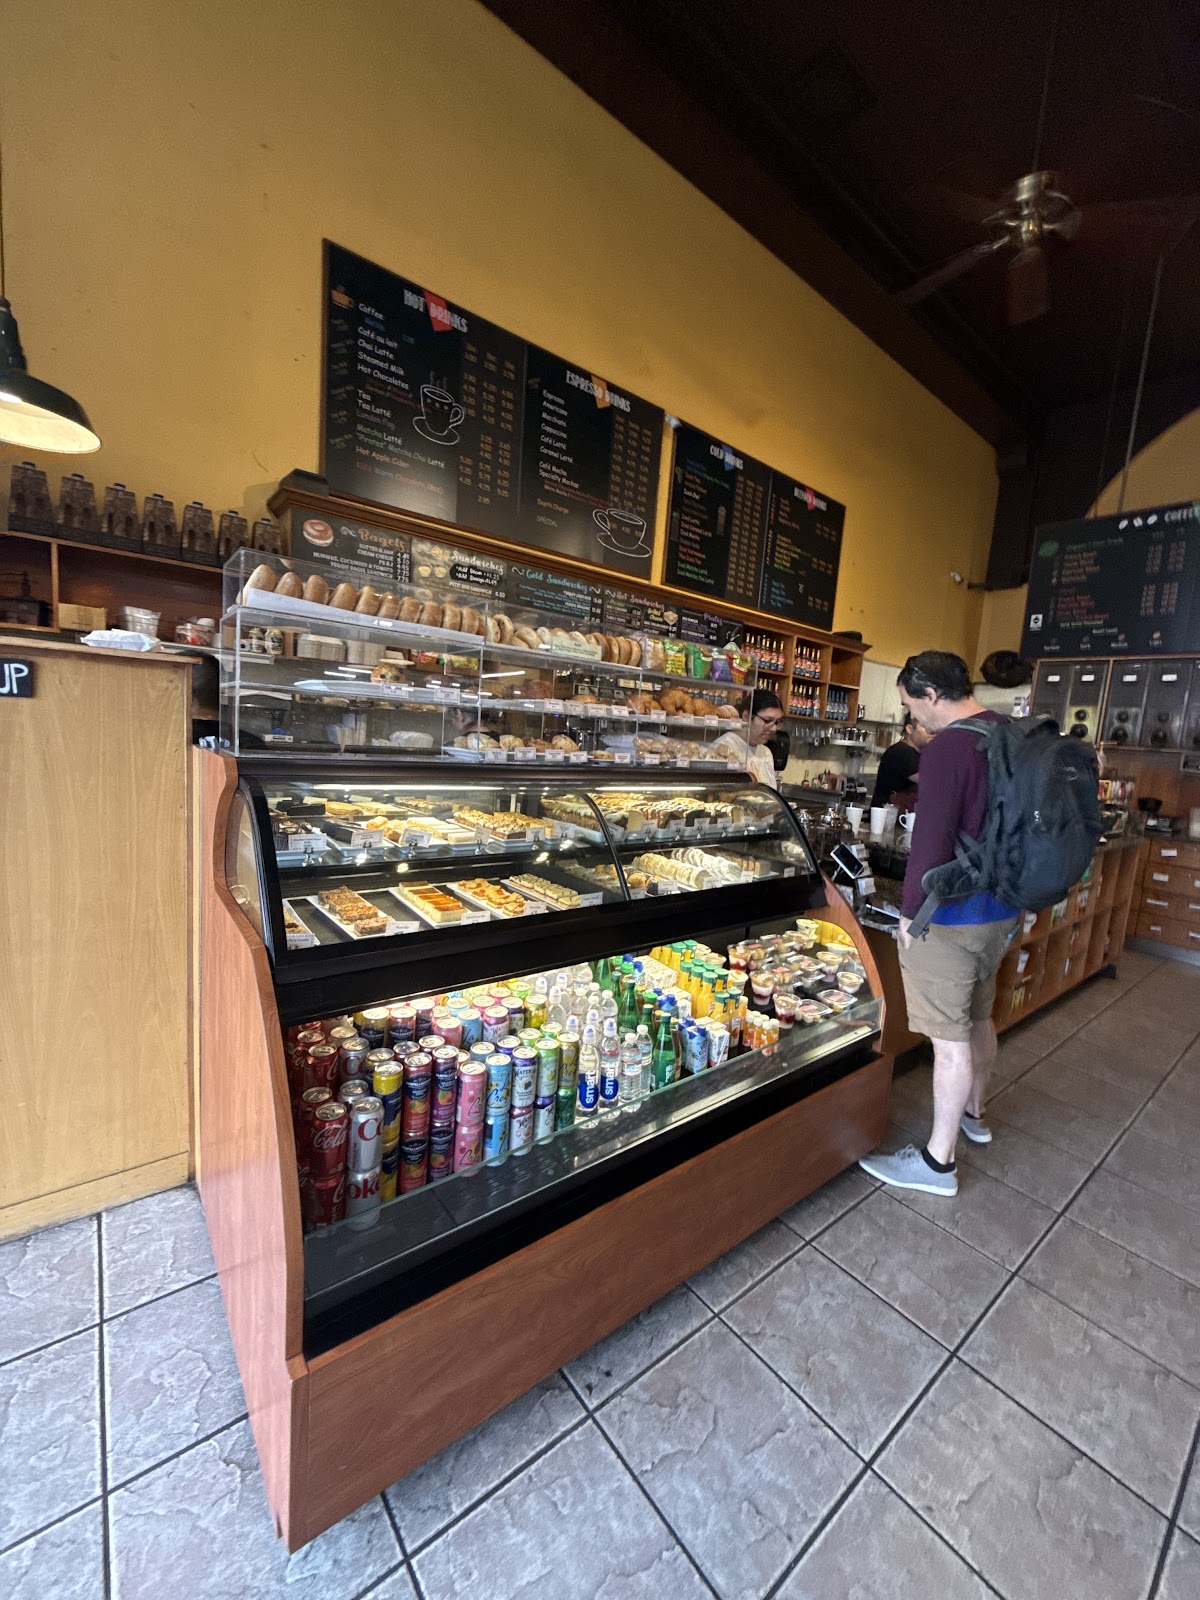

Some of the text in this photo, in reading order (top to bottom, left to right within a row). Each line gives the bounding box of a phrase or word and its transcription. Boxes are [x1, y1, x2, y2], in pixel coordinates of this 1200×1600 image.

[358, 303, 384, 320] Coffee
[404, 289, 468, 333] HOT DRINKS
[358, 351, 389, 370] Steamed
[390, 364, 404, 376] Milk
[357, 363, 370, 374] Hot
[372, 370, 409, 390] Chocolates
[357, 389, 371, 401] Tea
[357, 399, 370, 410] Tea
[542, 400, 568, 416] Americano
[709, 444, 724, 460] COLD
[358, 528, 406, 553] Bagels
[357, 549, 394, 562] CREAM CHEESE
[451, 550, 505, 576] Sandwiches
[330, 561, 394, 579] VEGGIE BAGEL SANDWICH
[340, 557, 368, 568] CUCUMBER
[373, 564, 394, 573] TOMATO
[396, 569, 410, 578] 7.75
[470, 586, 493, 596] SANDWICH
[526, 569, 588, 595] Cold Sandwiches
[616, 590, 628, 600] Hot
[630, 594, 665, 612] Sandwiches
[586, 1070, 596, 1104] smart
[605, 1062, 615, 1096] smart
